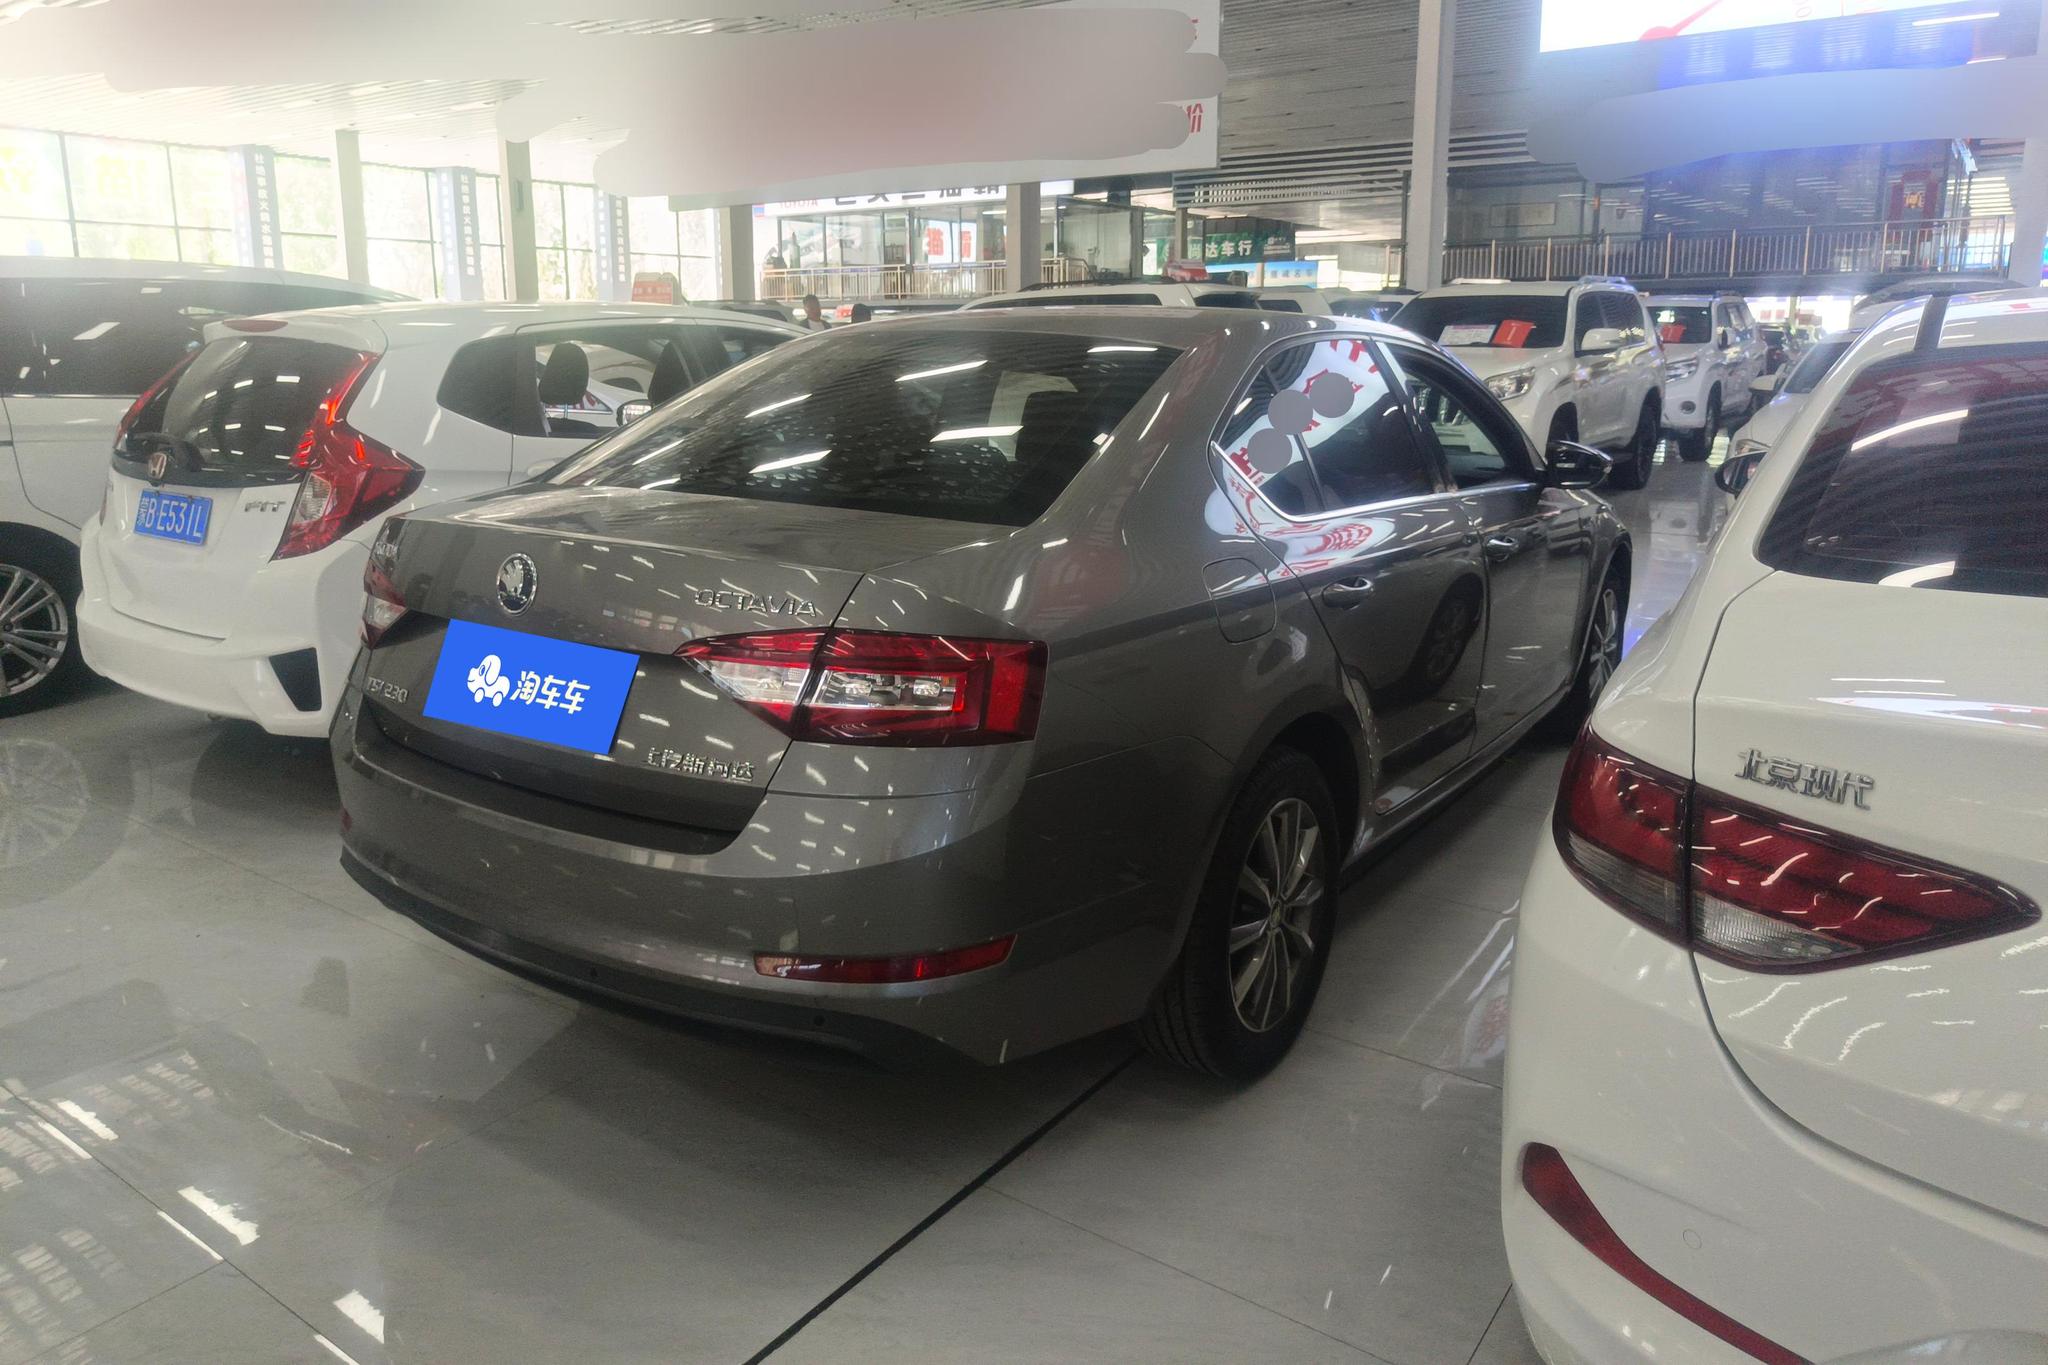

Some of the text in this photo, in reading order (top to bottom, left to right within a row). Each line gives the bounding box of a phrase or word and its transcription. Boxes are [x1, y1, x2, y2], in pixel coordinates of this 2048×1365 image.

[695, 589, 816, 617] OCTAVIA
[384, 683, 408, 703] 230
[643, 746, 755, 783] 上汽斯柯达
[1734, 748, 1875, 811] 北京现代
